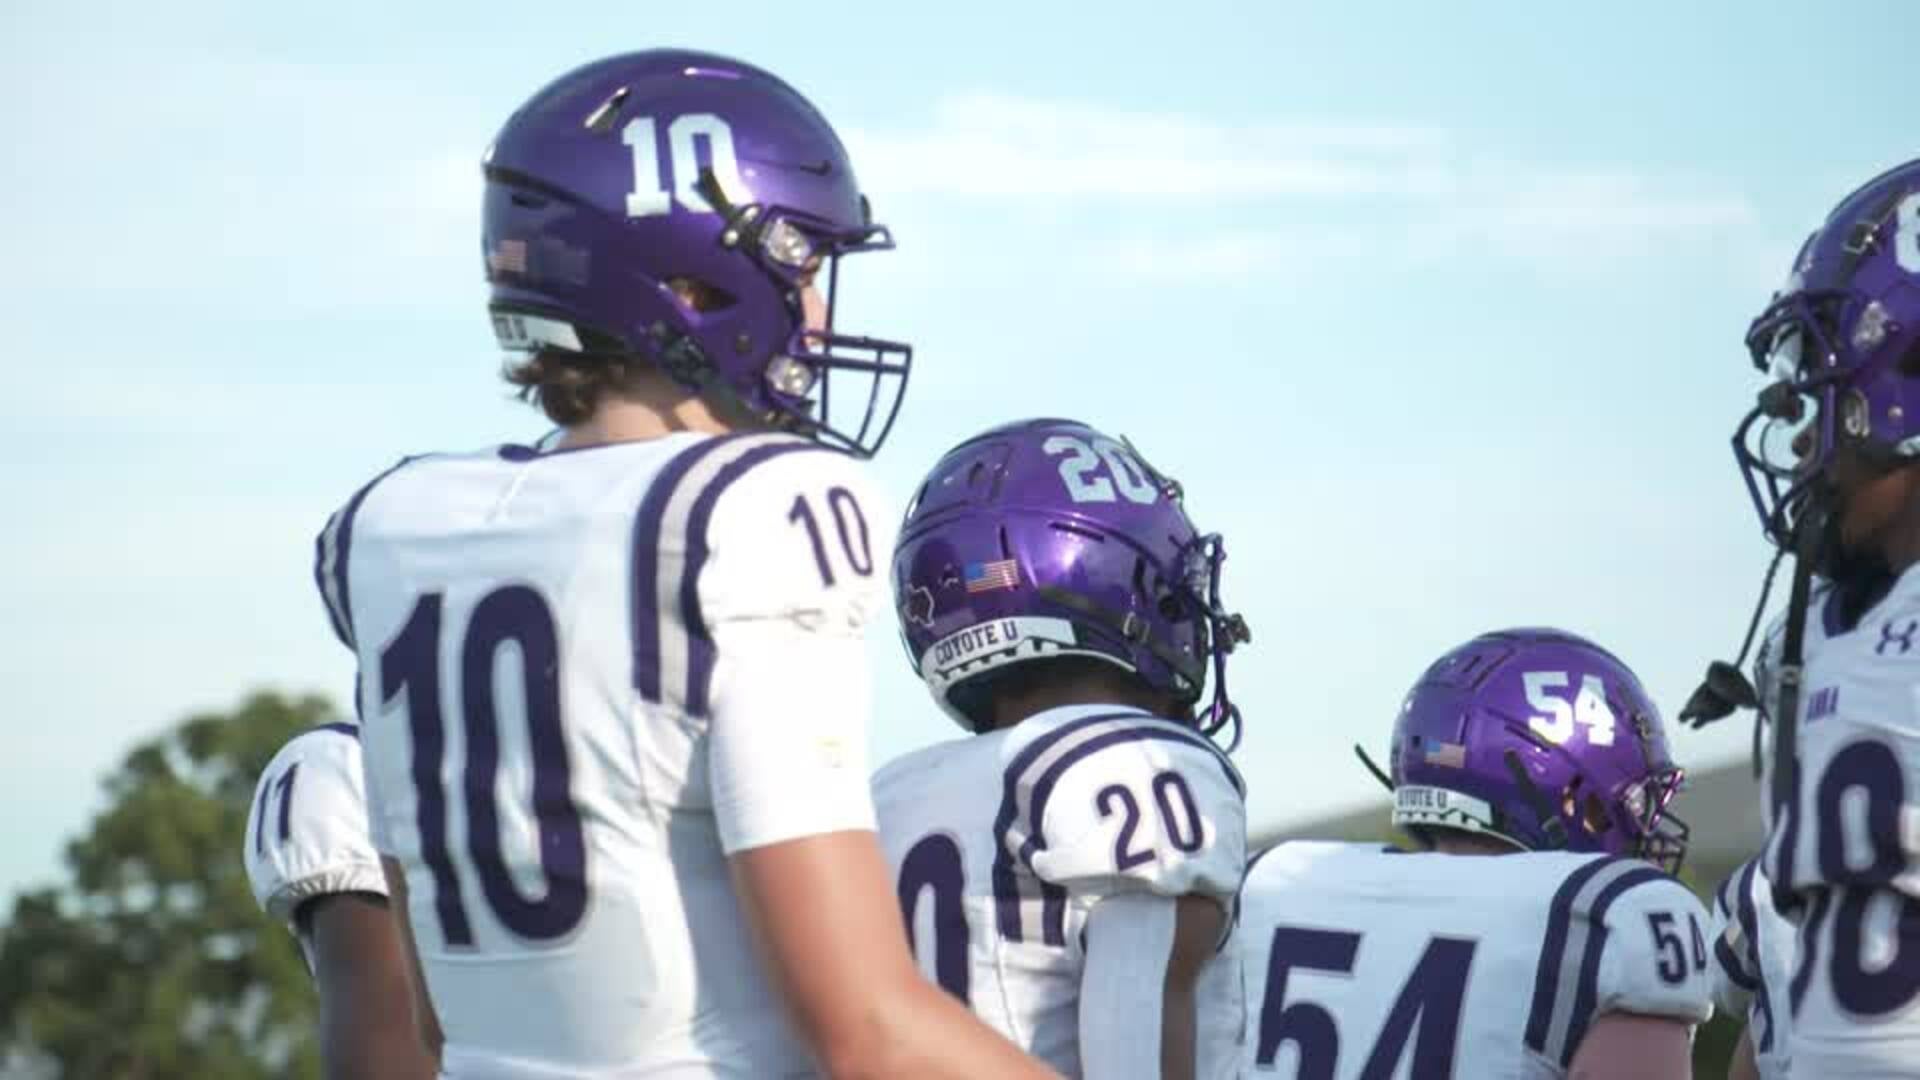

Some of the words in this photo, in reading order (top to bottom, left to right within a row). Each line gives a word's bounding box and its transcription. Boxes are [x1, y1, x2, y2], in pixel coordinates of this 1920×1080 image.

[622, 113, 753, 217] 10
[1042, 434, 1159, 504] 20
[787, 486, 873, 587] 10
[934, 624, 998, 665] COYOTE
[1002, 620, 1018, 641] U
[1521, 671, 1616, 746] 54
[379, 583, 592, 952] 10
[1096, 770, 1204, 872] 20
[1255, 925, 1479, 1080] 54
